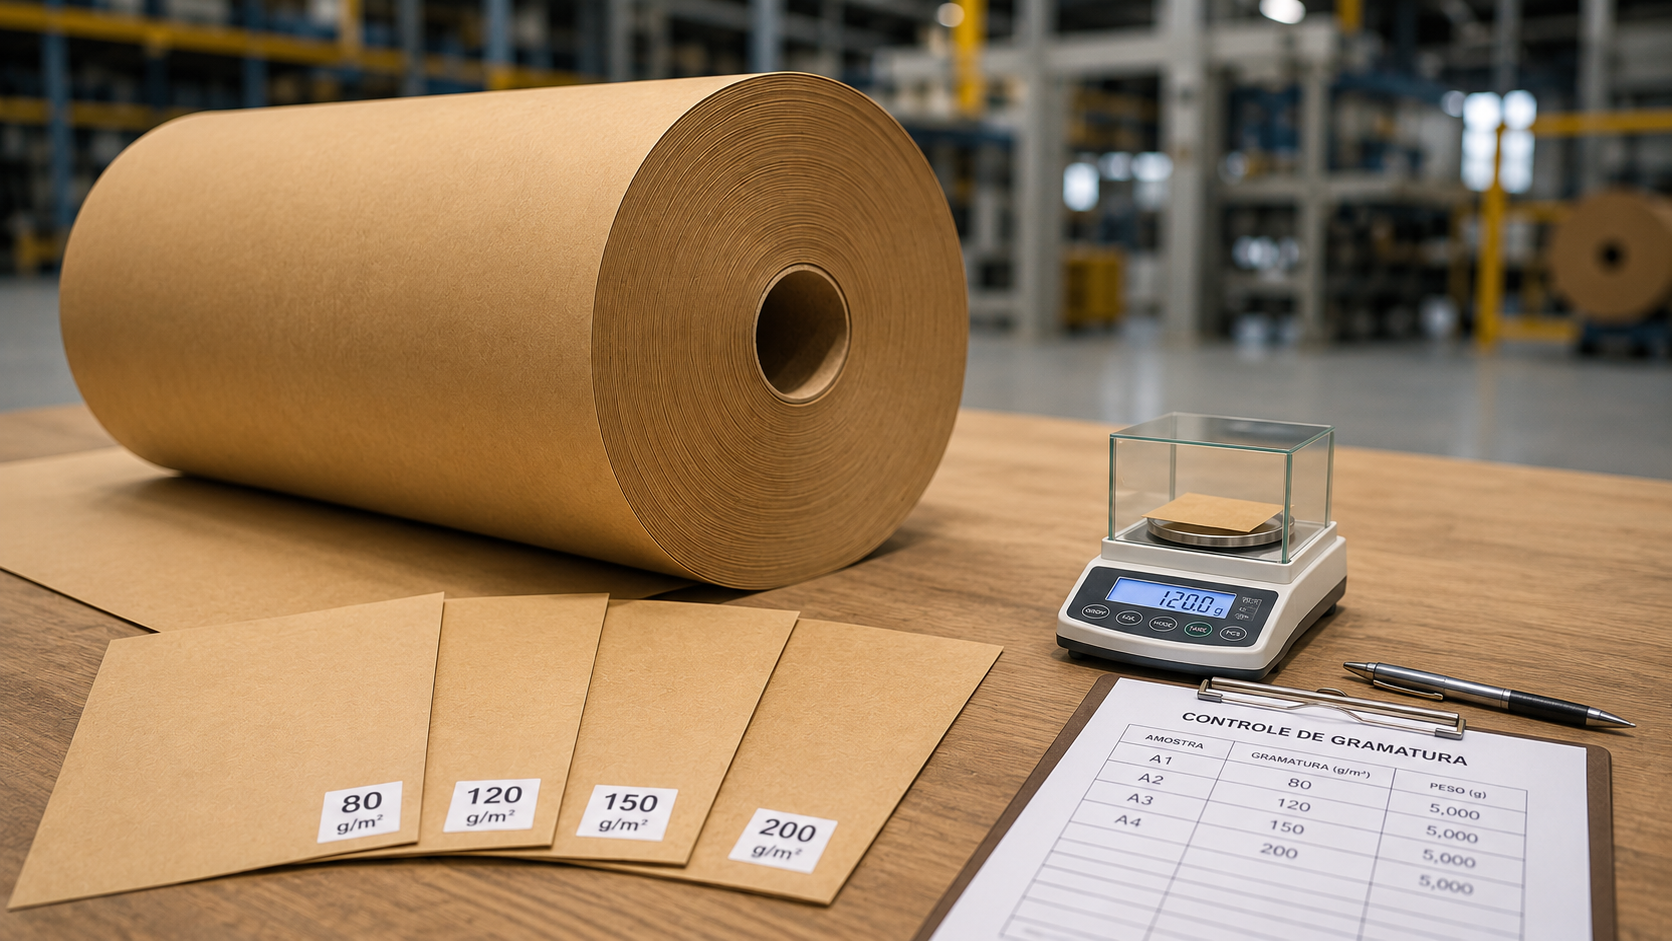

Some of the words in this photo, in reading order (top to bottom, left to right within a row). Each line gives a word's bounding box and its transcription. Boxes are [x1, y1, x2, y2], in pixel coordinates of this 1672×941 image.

[1159, 590, 1215, 613] 120.0
[1213, 607, 1223, 617] g
[1144, 734, 1204, 750] AMOSTRA
[1182, 712, 1292, 737] CONTROLE
[1296, 729, 1325, 742] DE
[1330, 735, 1468, 766] GRAMATURA
[1149, 754, 1173, 765] A1
[1251, 751, 1329, 771] GRAMATURA
[1138, 773, 1164, 785] A2
[1288, 778, 1312, 790] 80
[467, 786, 523, 805] 120
[1126, 793, 1154, 806] A3
[1430, 782, 1466, 795] PESO
[1469, 789, 1487, 800] (g)
[341, 791, 383, 813] 80
[604, 793, 658, 813] 150
[1277, 798, 1311, 812] 120
[466, 809, 516, 827] g/m²
[1114, 814, 1142, 827] A4
[1429, 803, 1481, 821] 5,000
[336, 814, 384, 835] g/m²
[598, 818, 649, 833] g/m²
[758, 818, 817, 843] 200
[1269, 820, 1305, 835] 150
[1425, 825, 1479, 844] 5,000
[751, 844, 803, 861] g/m²
[1260, 842, 1298, 860] 200
[1422, 849, 1477, 869] 5,000
[1418, 874, 1475, 895] 5,000
